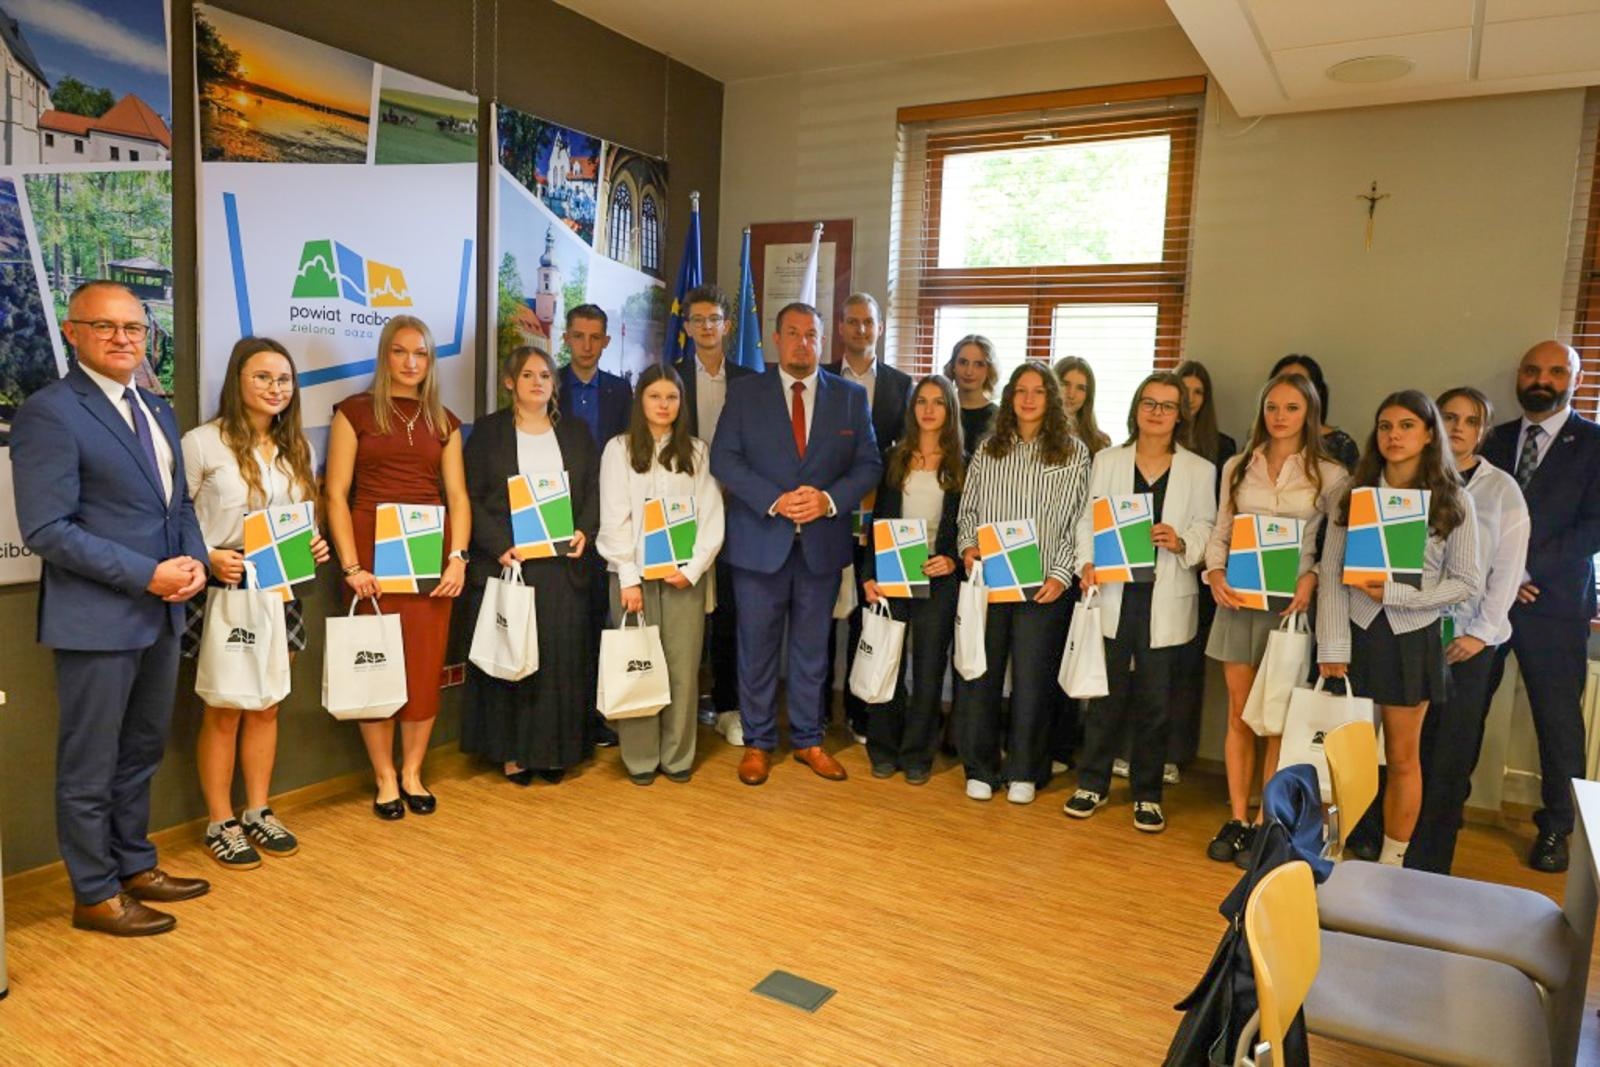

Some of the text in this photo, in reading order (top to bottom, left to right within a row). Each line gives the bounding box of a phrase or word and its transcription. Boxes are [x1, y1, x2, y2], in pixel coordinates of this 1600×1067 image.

[290, 305, 391, 326] powiat racibo
[290, 323, 373, 338] zielona oaza
